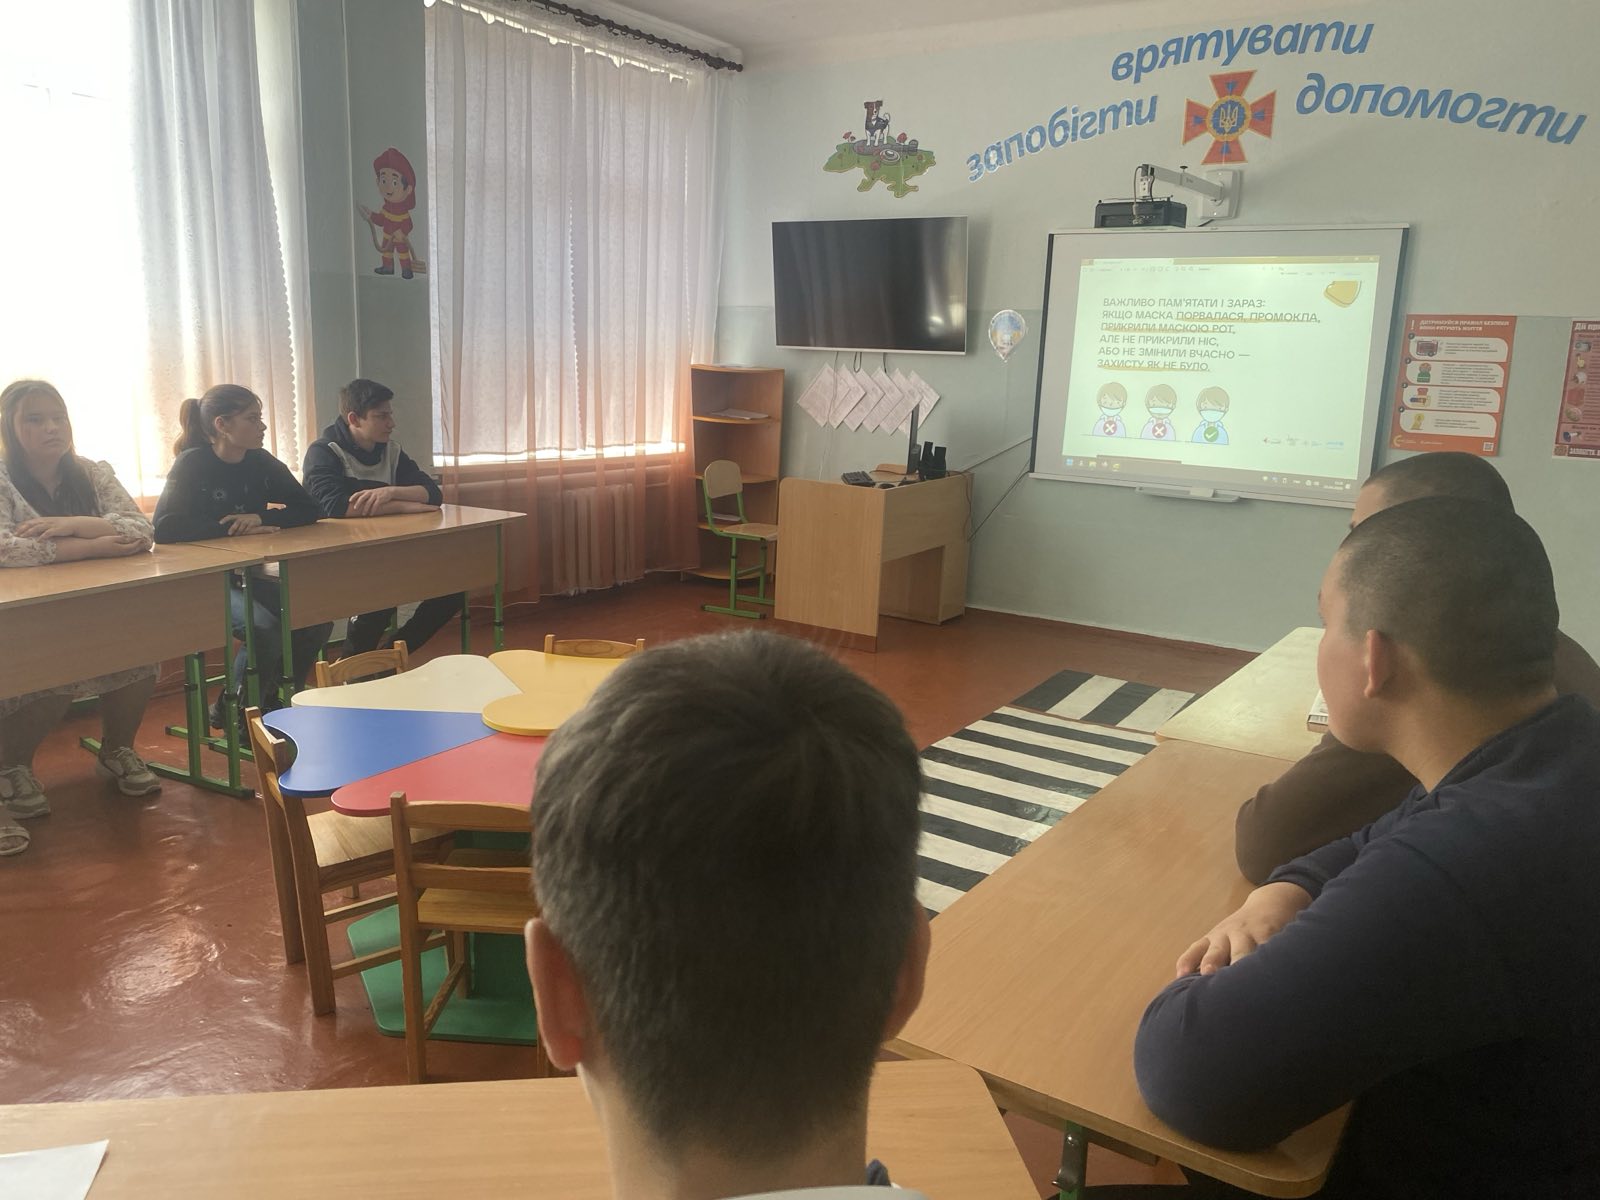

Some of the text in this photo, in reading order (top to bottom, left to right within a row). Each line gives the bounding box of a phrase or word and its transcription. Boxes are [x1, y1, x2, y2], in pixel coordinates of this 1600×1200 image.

[1111, 19, 1374, 84] врятувати
[1295, 72, 1588, 146] допомогти
[966, 94, 1158, 183] запобігти
[1103, 298, 1155, 307] ВАЖЛИВО
[1159, 298, 1218, 308] ПАМ'ЯТАТИ
[1227, 299, 1266, 308] ЗАРАЗ:
[1102, 310, 1132, 320] ЯКЩО
[1136, 311, 1173, 320] МАСКА
[1250, 312, 1321, 323] ПРОМОКЛА,
[1100, 322, 1236, 334] ПРИКРИЛИ МАСКОЮ РОТ,
[1100, 335, 1219, 347] АЛЕ НЕ ПРИКРИЛИ НІС,
[1098, 347, 1120, 356] АБО
[1122, 347, 1136, 356] НЕ
[1138, 347, 1186, 357] ЗМІНИЛИ
[1189, 349, 1235, 359] ВЧАСНО
[1097, 359, 1210, 372] ЗАХИСТУ ЯК НЕ БУЛО.
